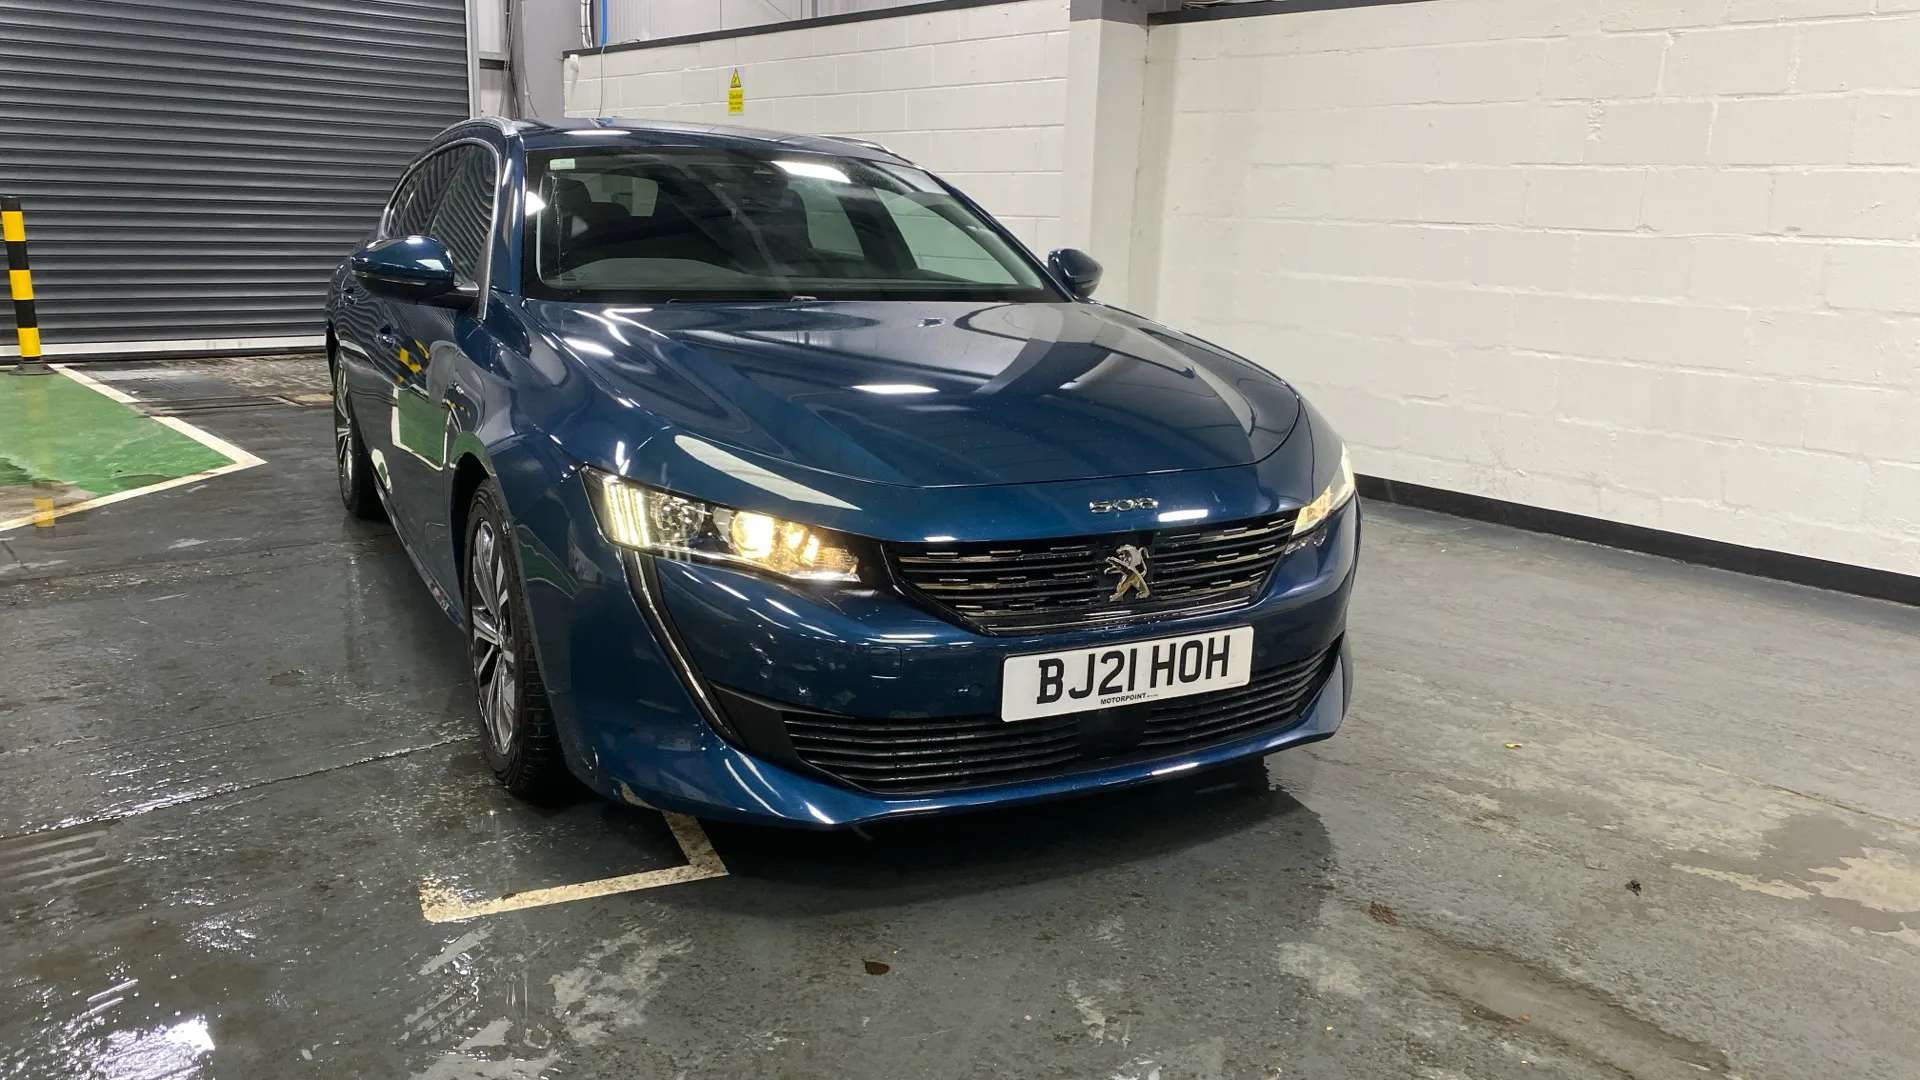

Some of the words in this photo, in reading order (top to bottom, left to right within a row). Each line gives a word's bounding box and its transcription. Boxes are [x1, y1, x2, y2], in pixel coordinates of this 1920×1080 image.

[1037, 648, 1137, 704] BJ21
[1150, 635, 1230, 688] HOH
[1100, 692, 1147, 705] MOTORPOINT
